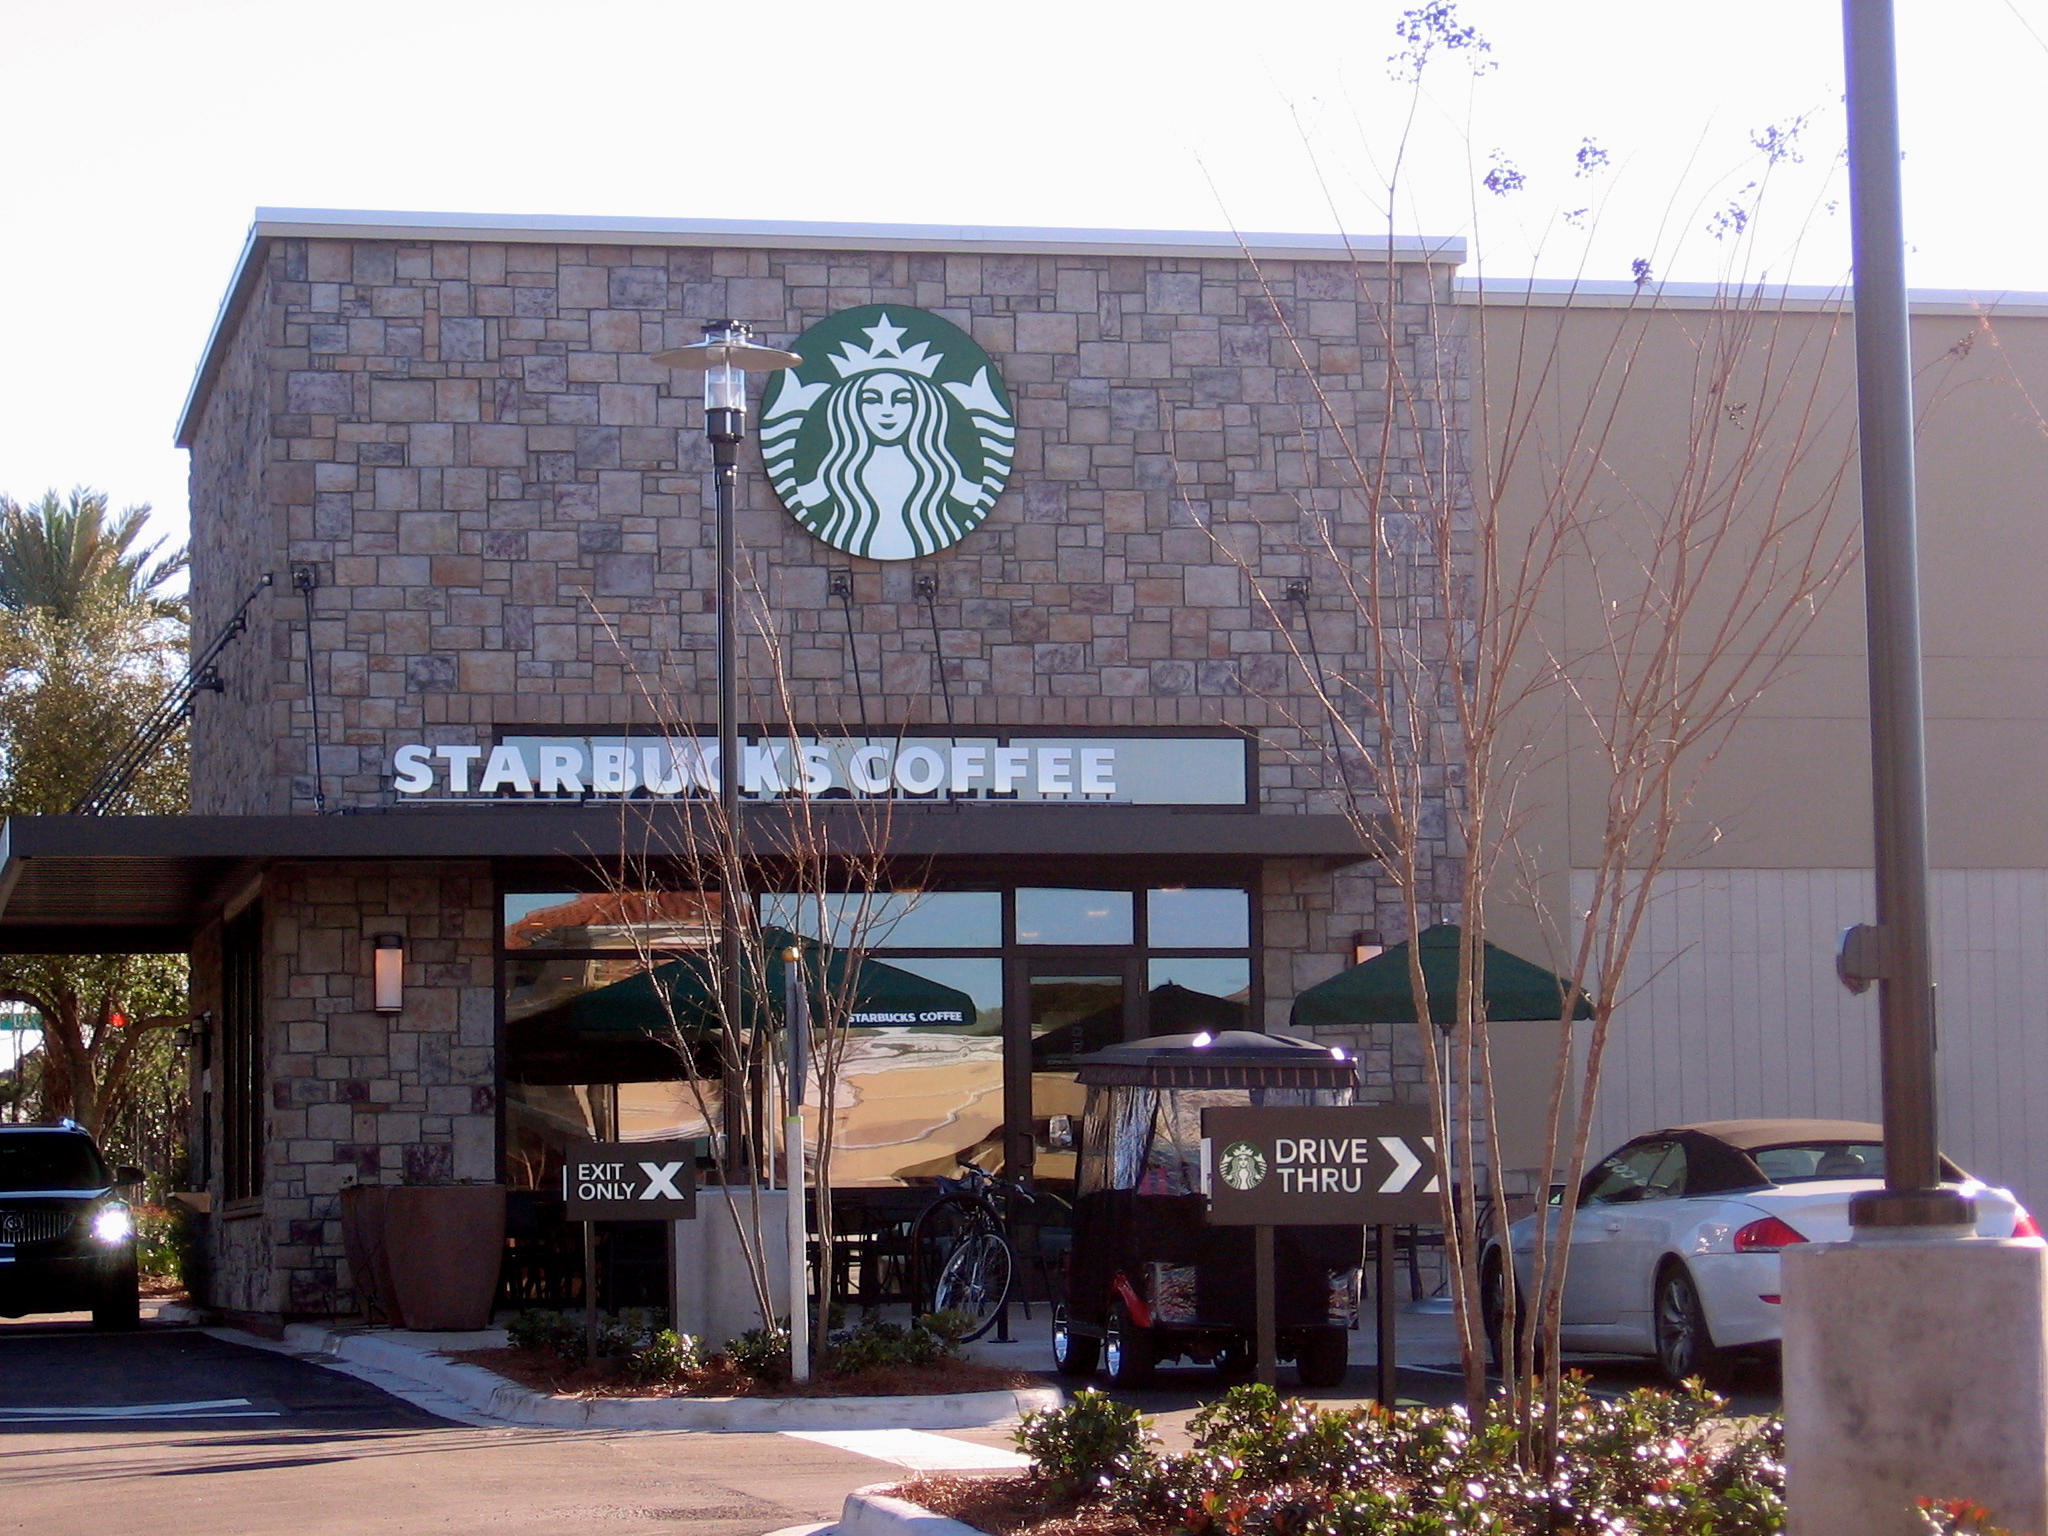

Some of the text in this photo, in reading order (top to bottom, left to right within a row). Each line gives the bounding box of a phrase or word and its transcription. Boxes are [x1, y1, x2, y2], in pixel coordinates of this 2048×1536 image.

[393, 744, 1116, 794] STARBUCKS COFFEE
[848, 1011, 963, 1023] STARBUCKS COFFEE
[1275, 1138, 1369, 1165] DRIVE
[578, 1163, 625, 1181] EXIT
[1276, 1167, 1362, 1194] THRU
[578, 1182, 636, 1201] ONLY
